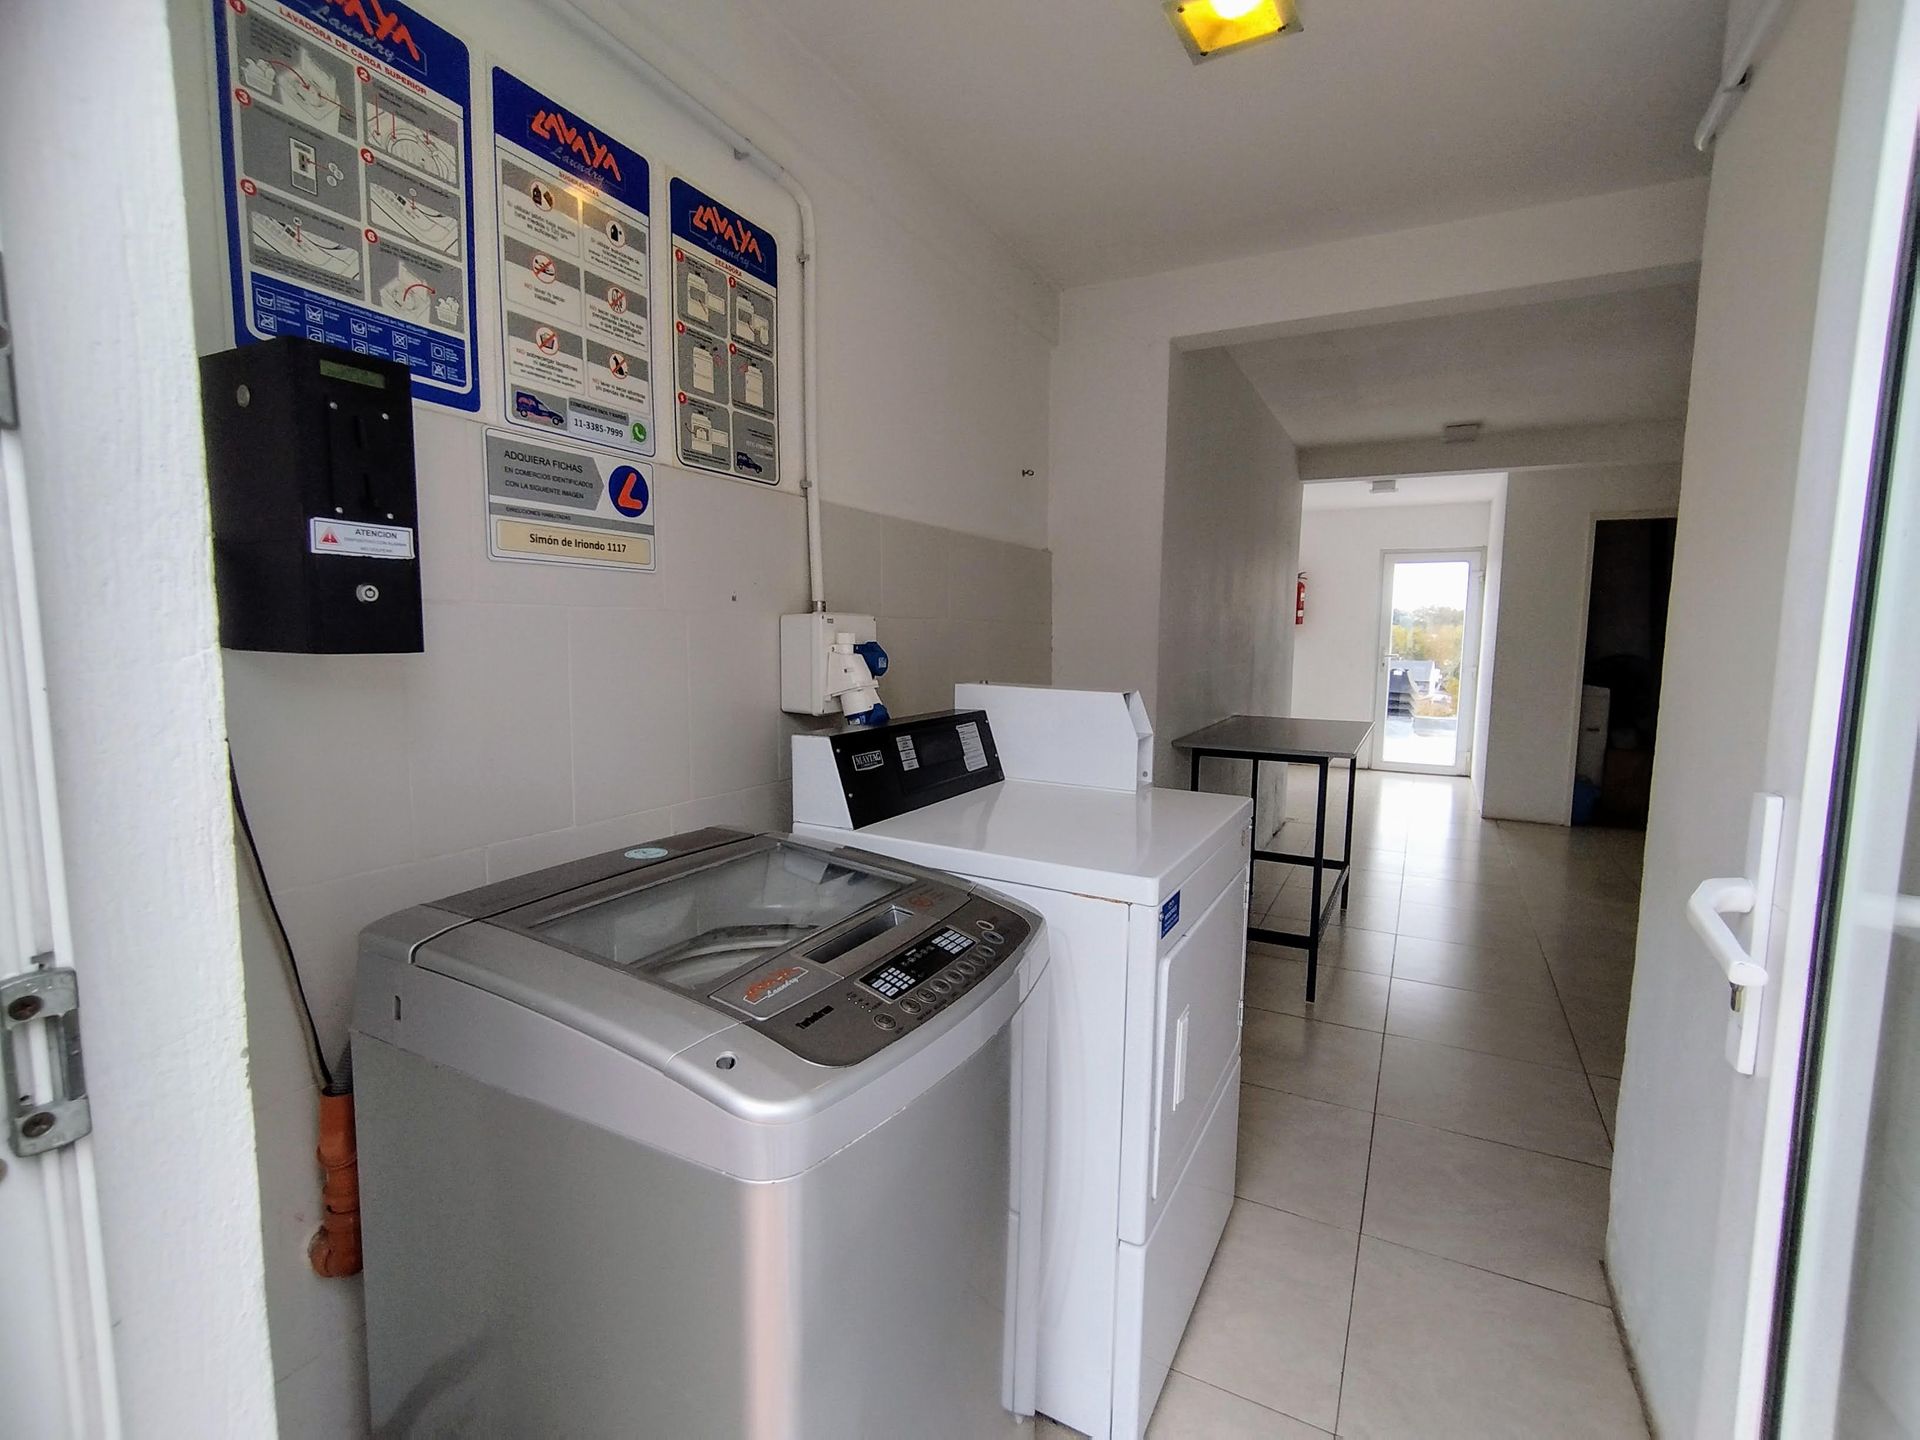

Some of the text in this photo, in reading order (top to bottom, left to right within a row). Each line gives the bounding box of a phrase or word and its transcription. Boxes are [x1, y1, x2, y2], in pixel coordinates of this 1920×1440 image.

[278, 6, 333, 44] LAVADORA
[335, 40, 348, 52] DE
[351, 48, 382, 71] CARGA
[385, 66, 427, 96] SUPERIOR
[573, 416, 624, 439] 11-3385-7999
[504, 449, 583, 473] ADQUIERA FICHAS
[504, 466, 594, 489] EN COMERCIOS IDENTIFICADOS
[505, 479, 585, 499] CON LA SIGUIENTE IMAGEN
[355, 528, 398, 539] ATENCION
[529, 533, 627, 553] Simón de Iriondo 1117
[854, 752, 882, 766] MAYTAG
